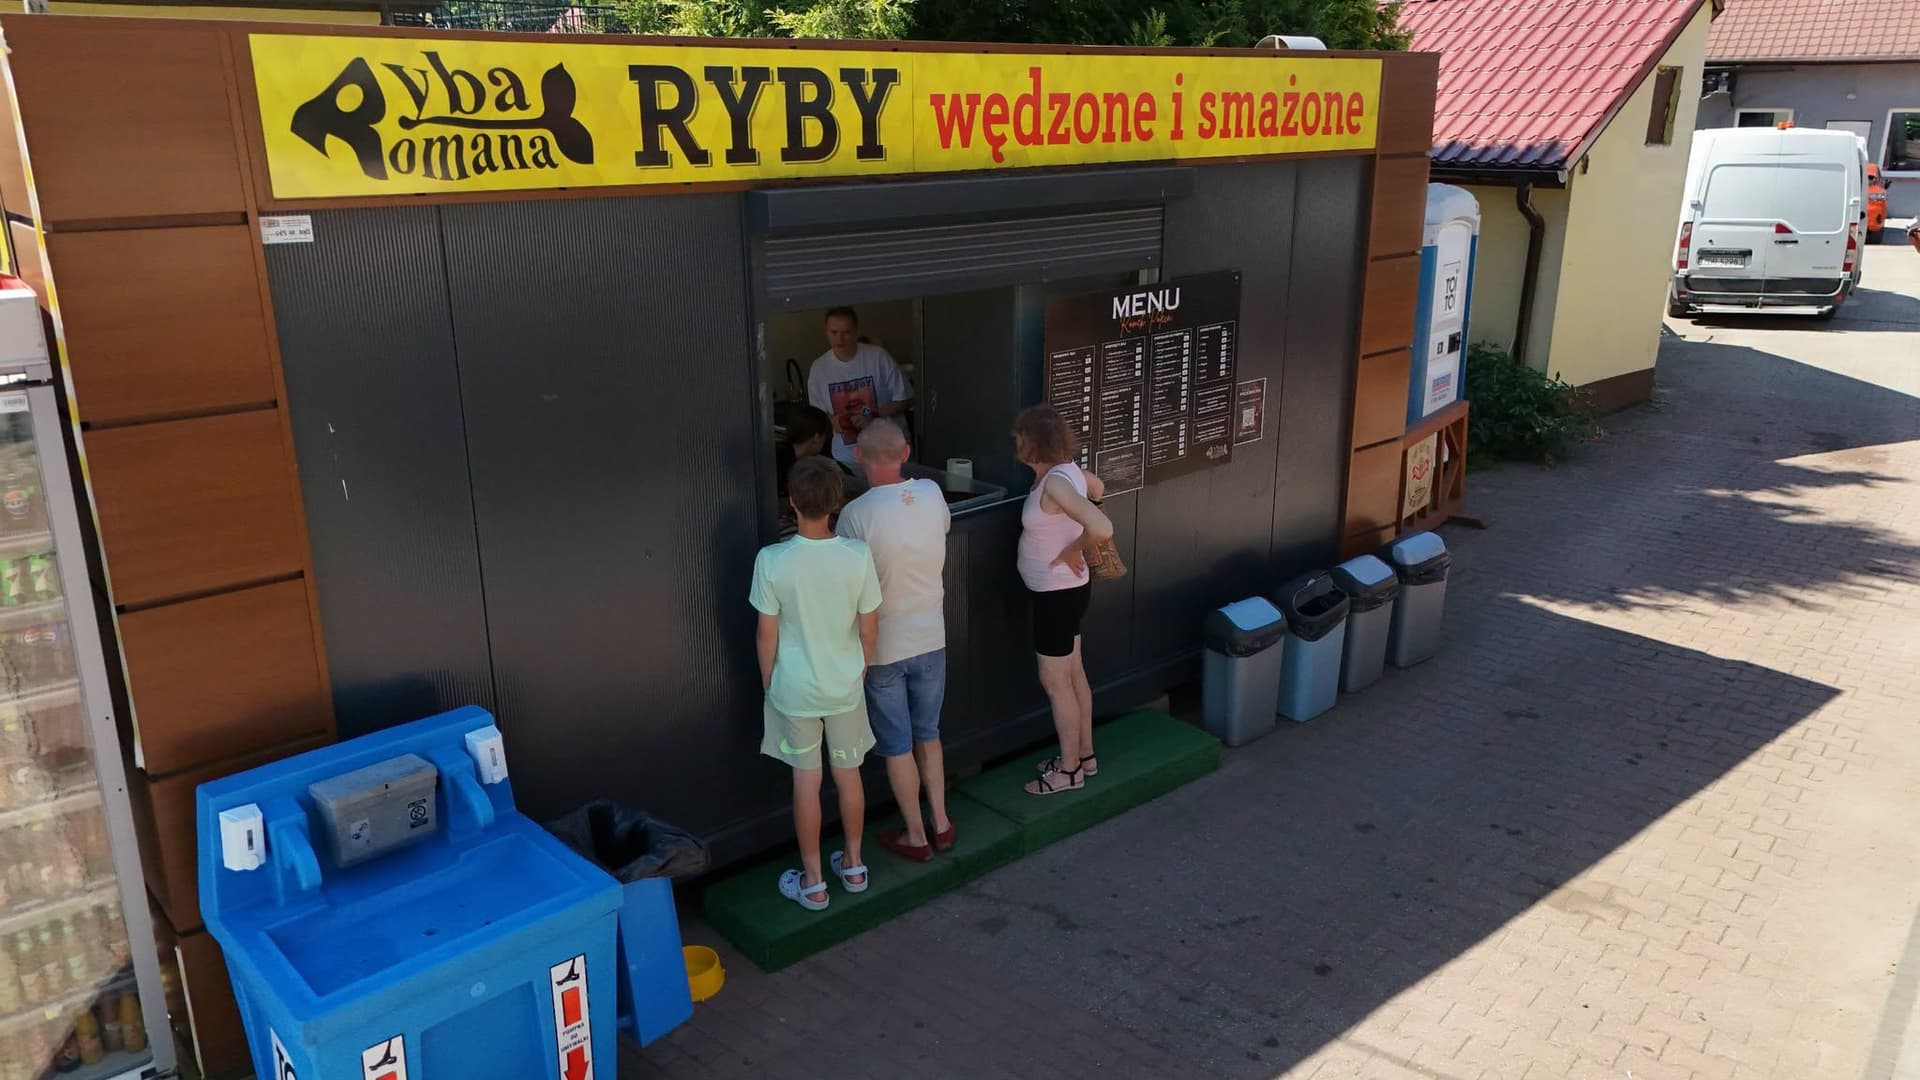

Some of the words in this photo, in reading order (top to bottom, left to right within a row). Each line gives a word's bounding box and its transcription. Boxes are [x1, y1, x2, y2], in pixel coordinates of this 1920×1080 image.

[628, 63, 901, 169] RYBY
[929, 66, 1157, 164] wędzone
[1169, 72, 1184, 141] i
[1197, 73, 1365, 139] smażone
[1111, 287, 1180, 320] MENU
